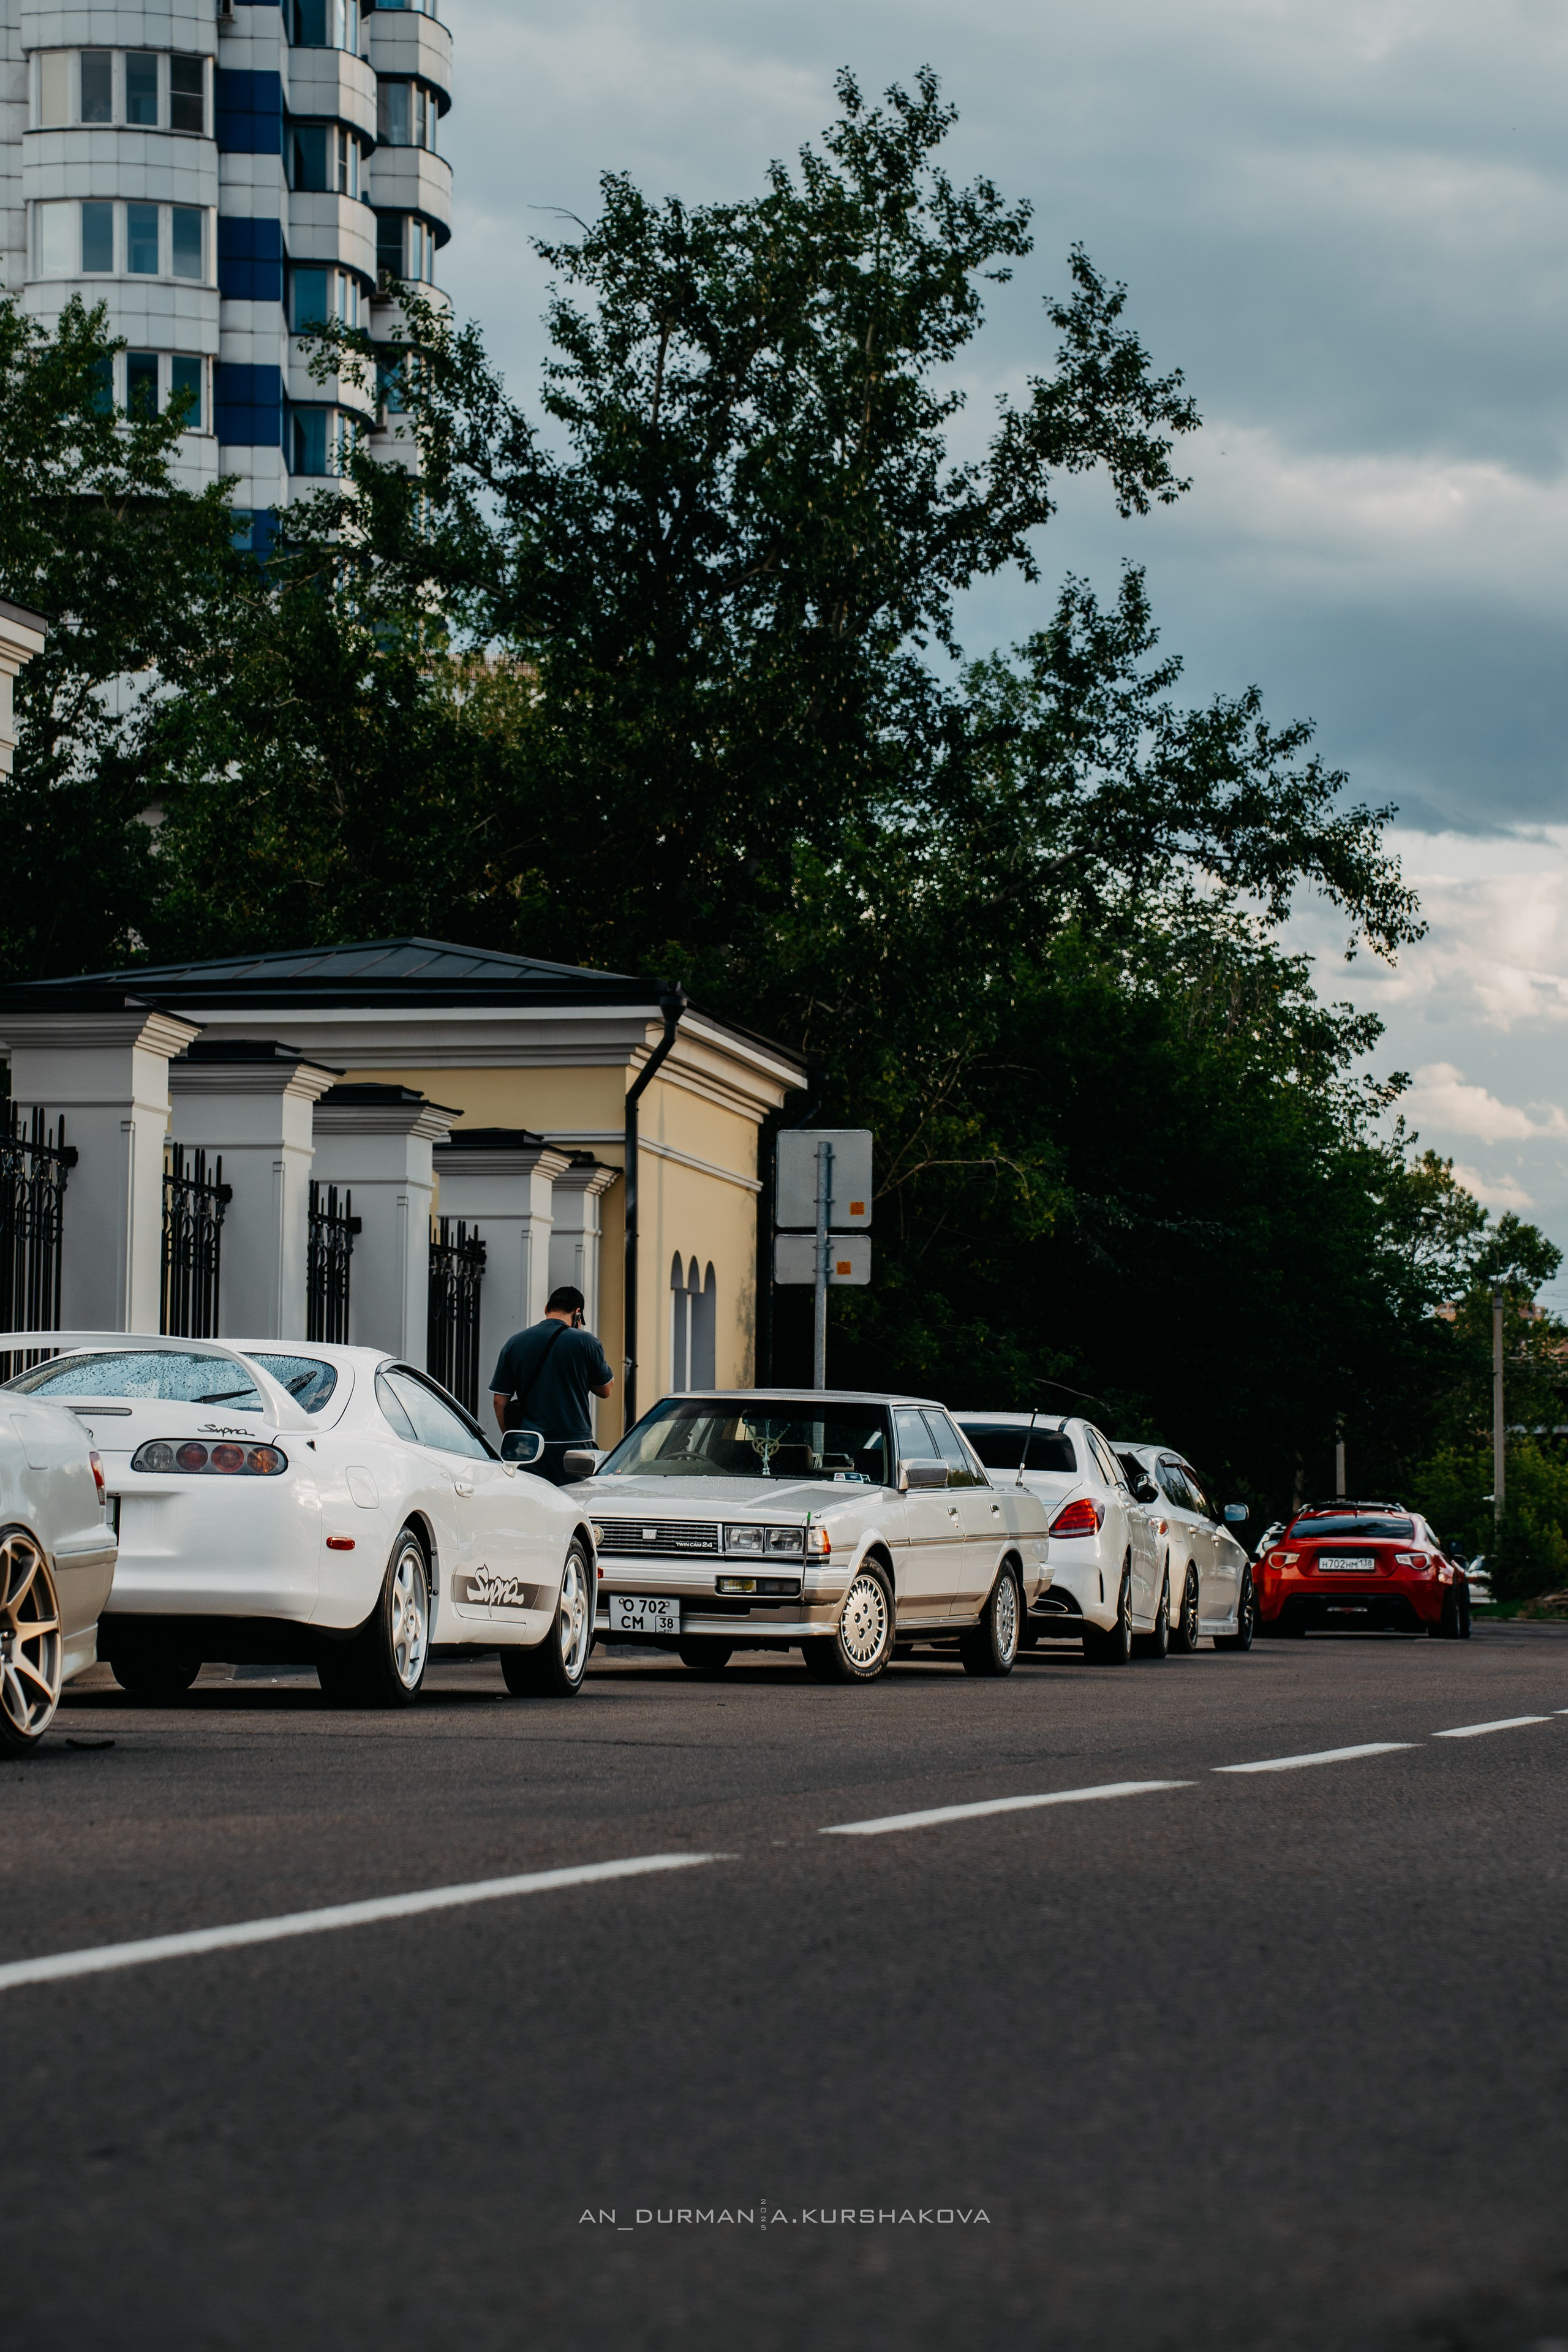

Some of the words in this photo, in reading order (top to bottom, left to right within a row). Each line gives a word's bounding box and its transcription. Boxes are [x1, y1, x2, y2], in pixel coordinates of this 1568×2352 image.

[197, 1424, 255, 1437] Supra
[467, 1564, 524, 1618] Supra
[660, 1618, 674, 1629] 38
